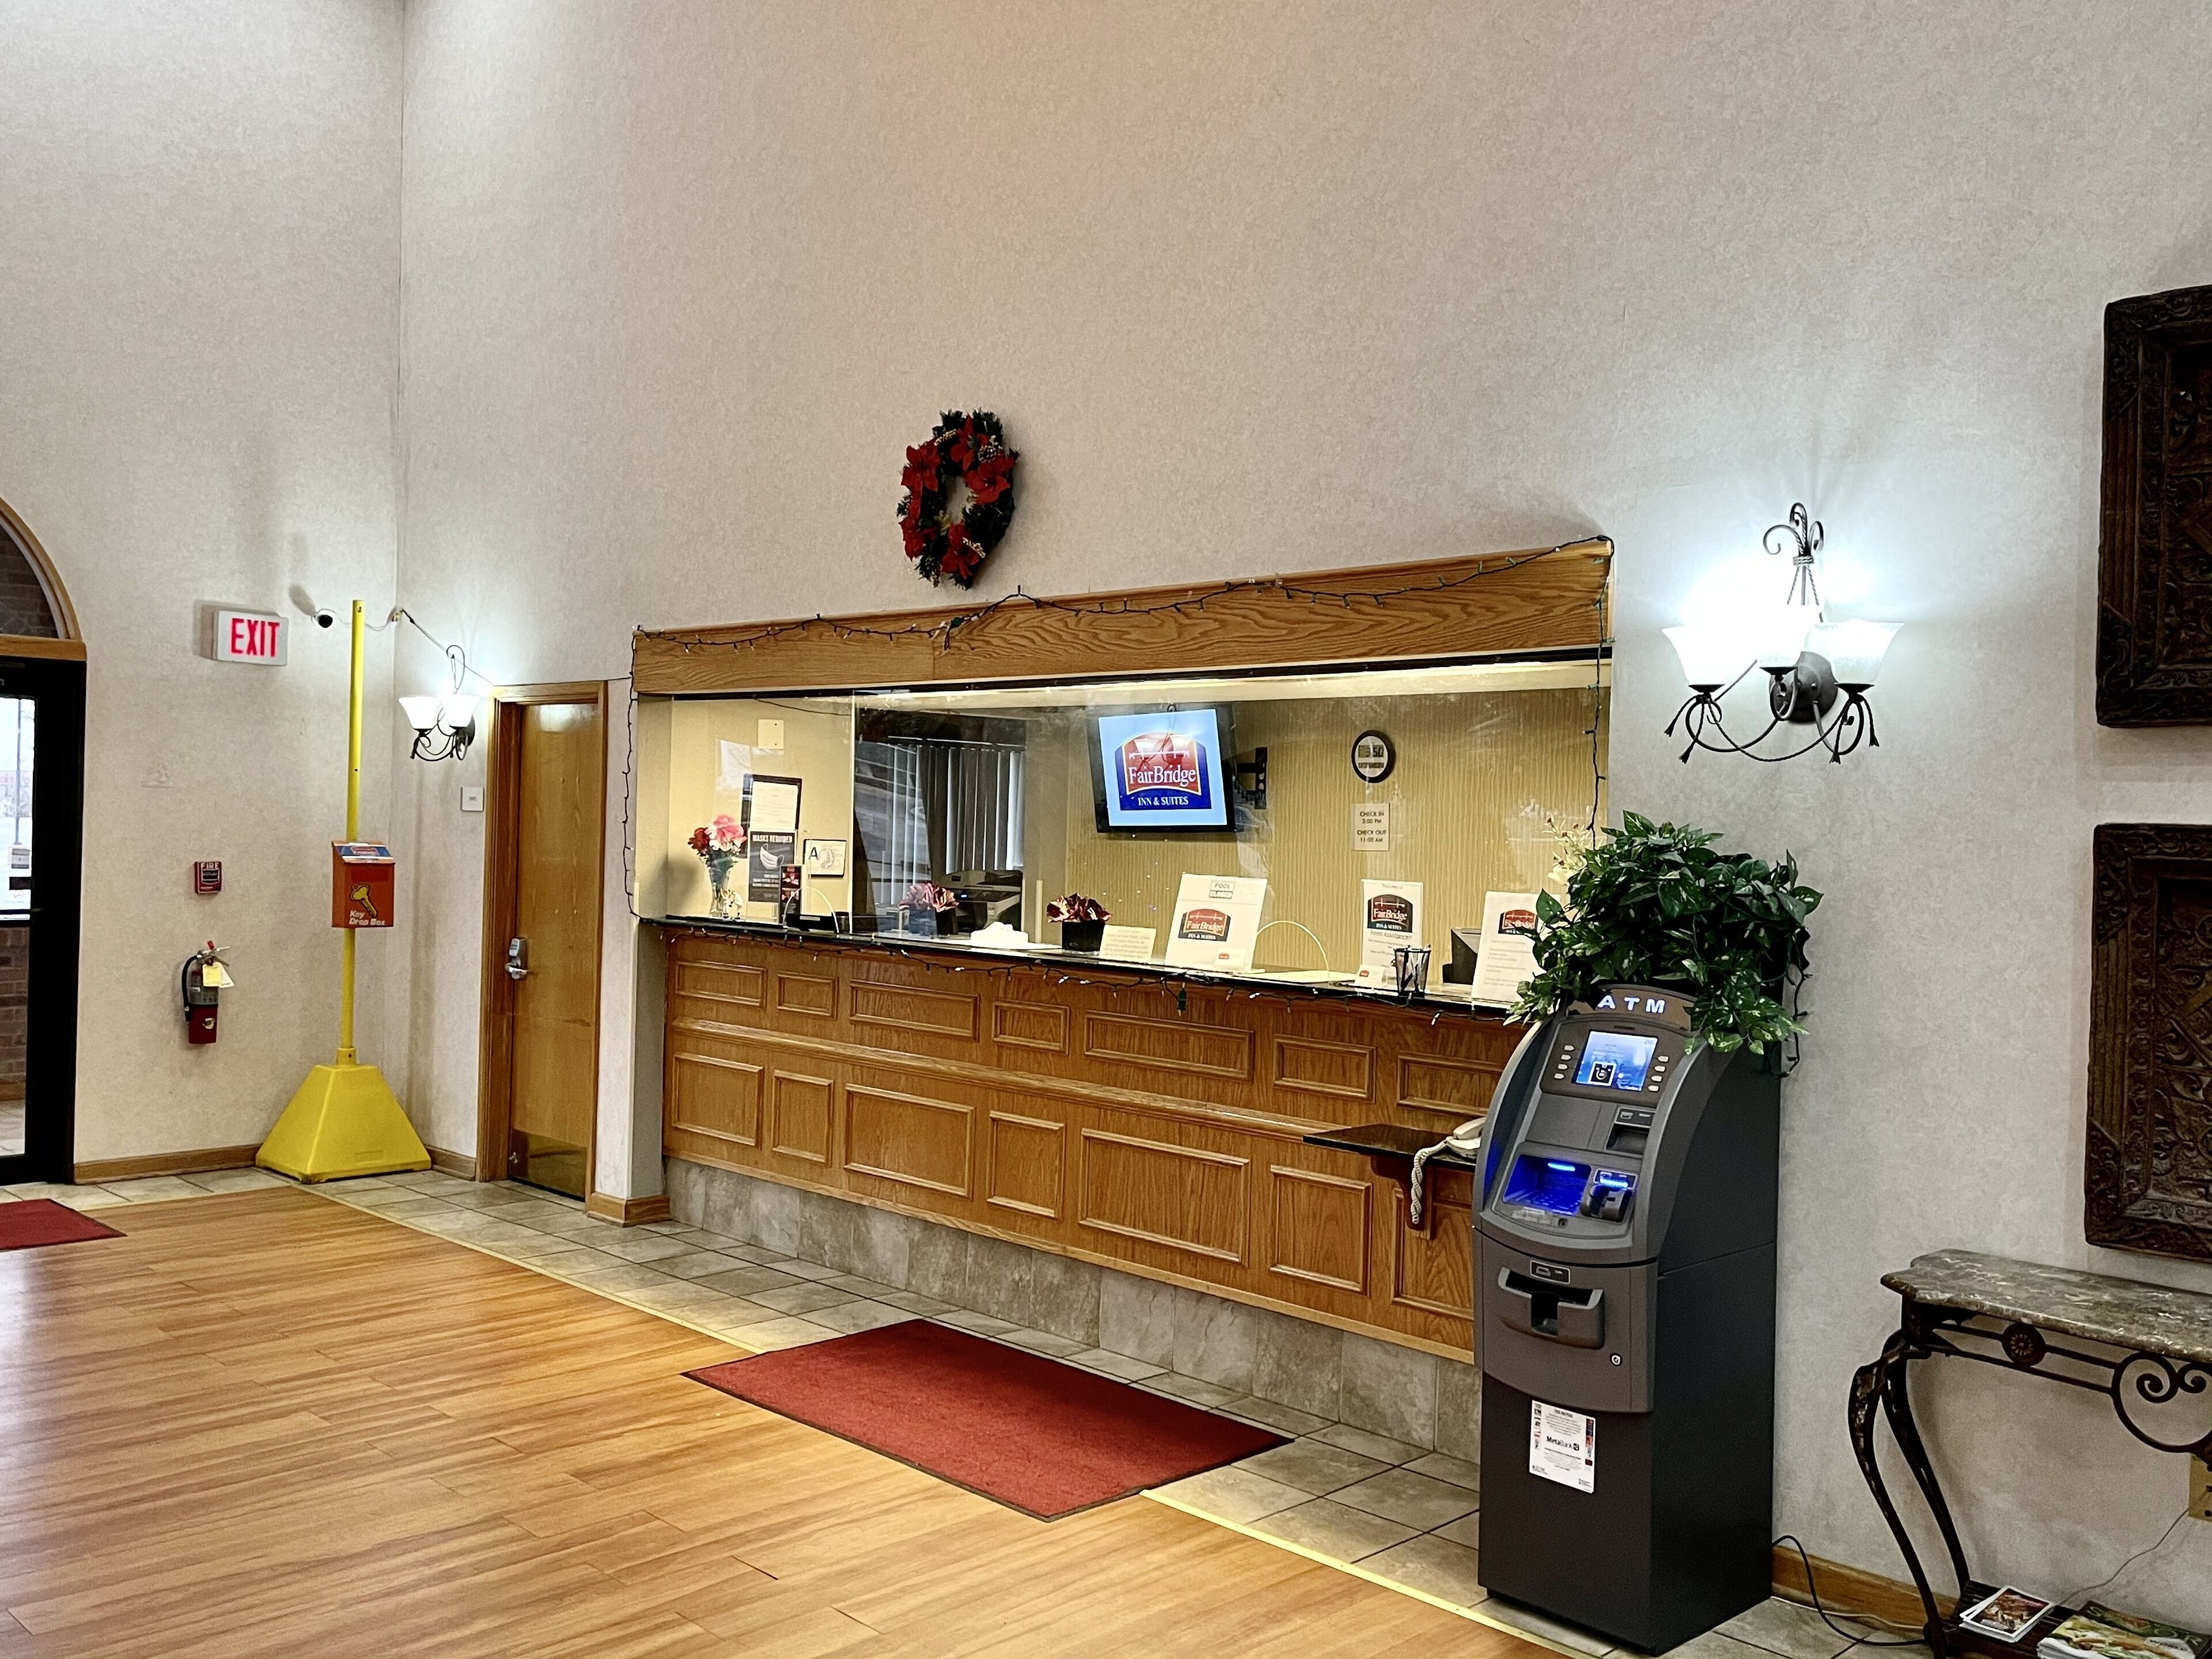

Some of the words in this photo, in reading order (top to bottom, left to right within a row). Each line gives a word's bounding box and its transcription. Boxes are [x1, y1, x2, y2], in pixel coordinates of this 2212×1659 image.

[231, 618, 280, 657] EXIT
[1128, 764, 1196, 787] FairBridge
[1138, 797, 1152, 806] INN
[1153, 797, 1160, 806] &
[1161, 796, 1189, 806] SUITES
[752, 834, 769, 842] MASKS
[770, 835, 793, 843] REQUIRED
[808, 846, 819, 860] A
[349, 910, 365, 919] Key
[1373, 908, 1408, 922] FairBridge
[349, 918, 369, 926] Drop
[369, 918, 386, 926] Box
[1187, 921, 1224, 933] FairBridge
[1597, 994, 1666, 1014] ATM
